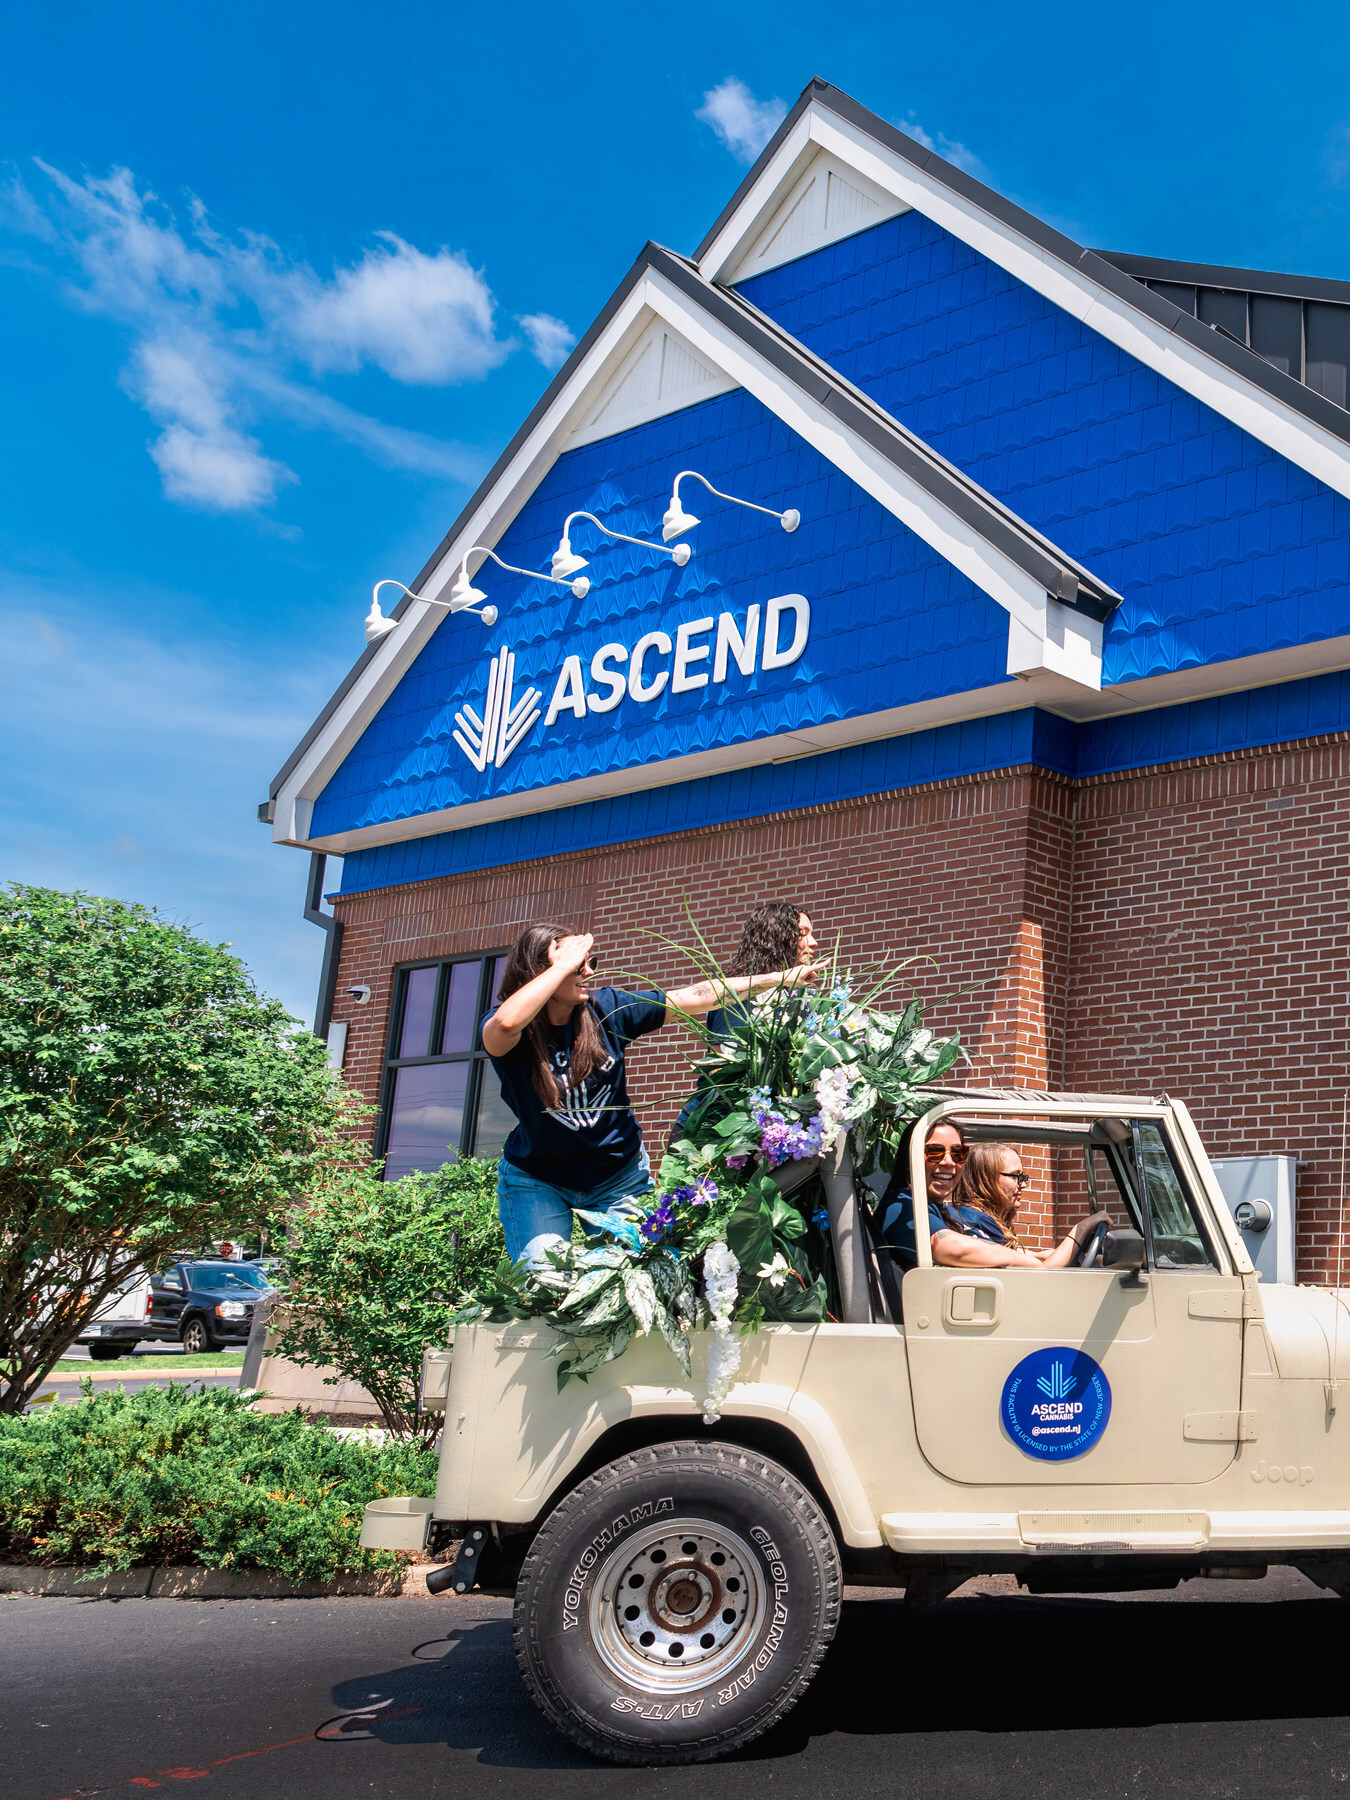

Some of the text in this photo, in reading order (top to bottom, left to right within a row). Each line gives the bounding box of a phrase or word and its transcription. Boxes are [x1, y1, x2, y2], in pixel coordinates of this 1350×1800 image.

[543, 593, 811, 727] ASCEND
[1010, 1377, 1023, 1394] THIS
[1008, 1393, 1018, 1424] FACILITY
[1030, 1402, 1083, 1416] ASCEND
[1040, 1413, 1074, 1421] CANNABIS
[1095, 1402, 1103, 1420] NEW
[1013, 1424, 1021, 1432] IS
[1031, 1424, 1081, 1437] @ascend.nj
[1090, 1419, 1098, 1430] OF
[1018, 1430, 1048, 1451] LICENSED
[1060, 1442, 1074, 1451] THE
[1073, 1429, 1092, 1447] STATE
[1049, 1445, 1059, 1453] BY
[562, 1497, 676, 1631] YOKOHAMA
[717, 1525, 790, 1707] GEOLANDAR
